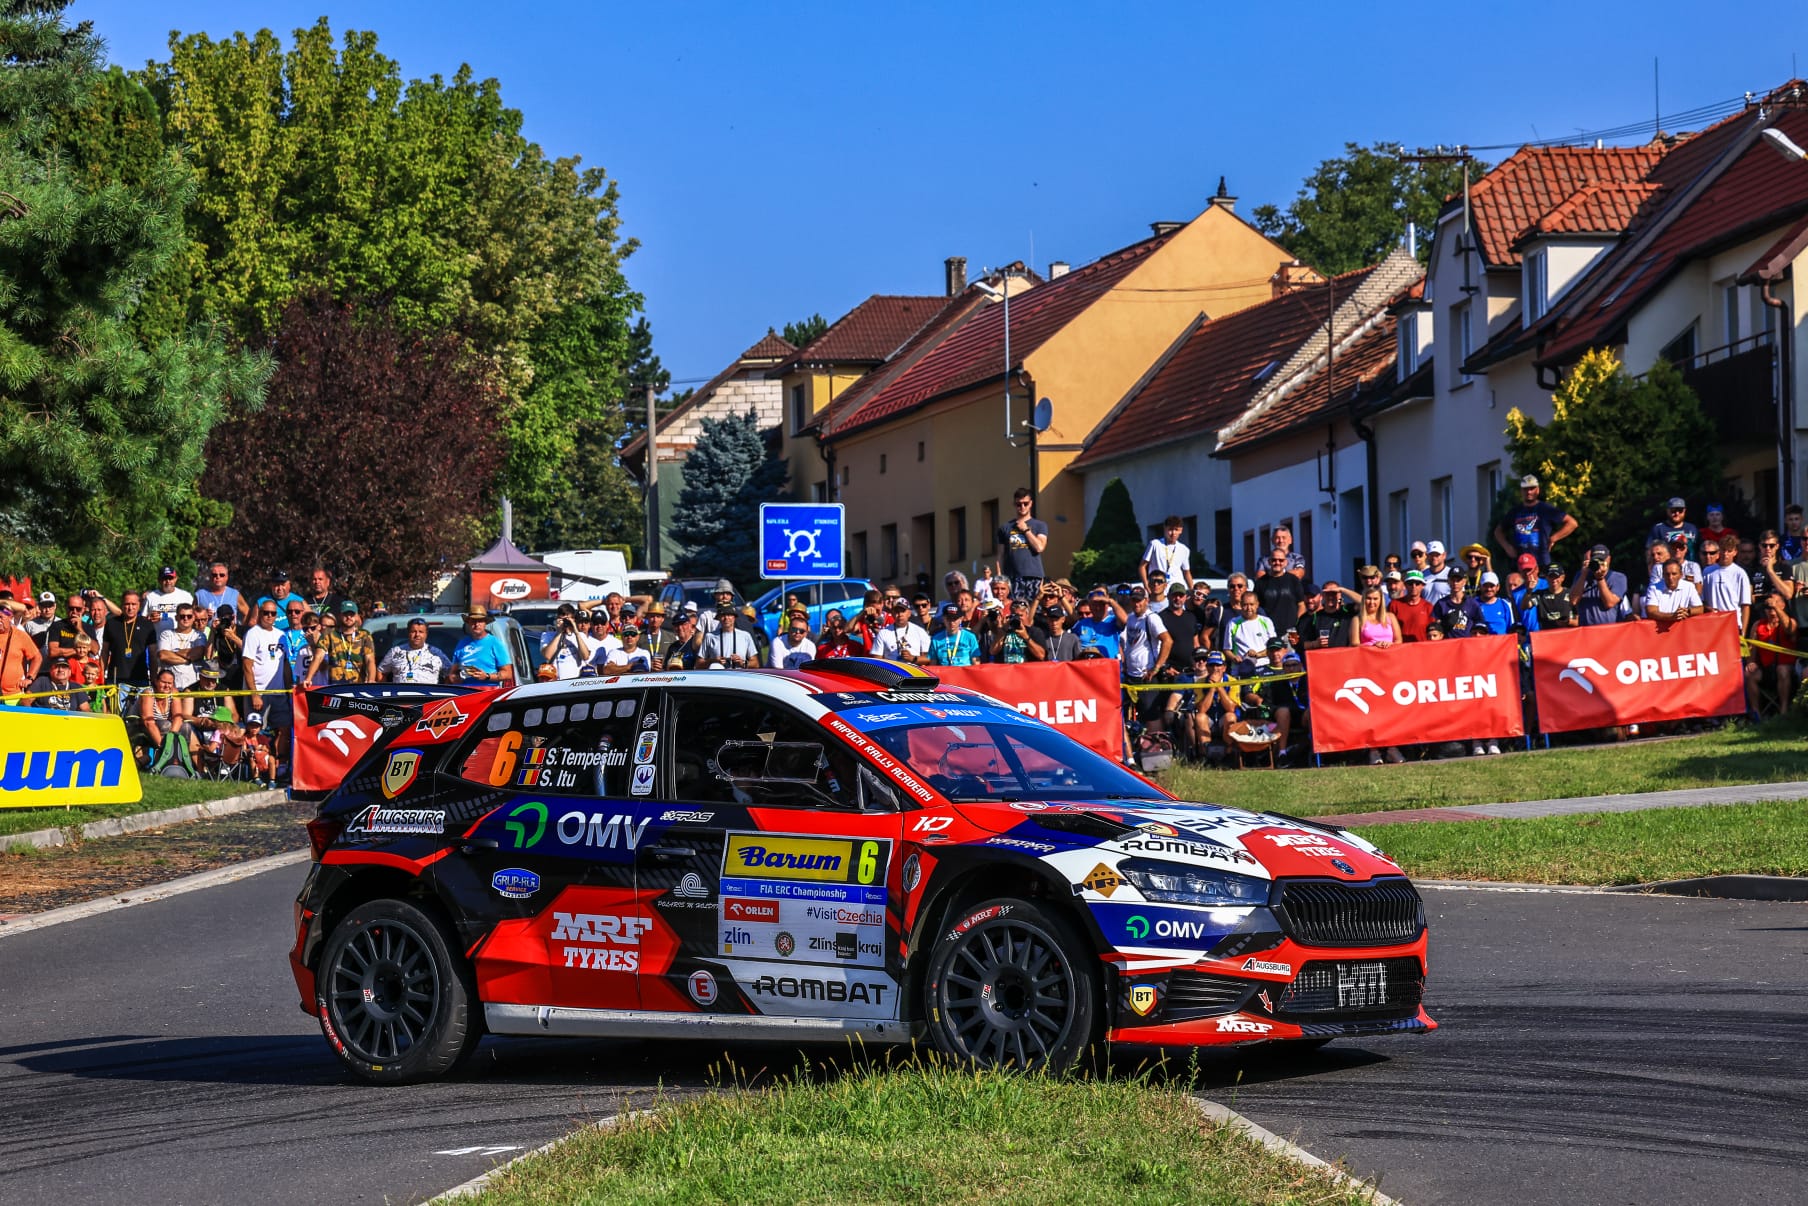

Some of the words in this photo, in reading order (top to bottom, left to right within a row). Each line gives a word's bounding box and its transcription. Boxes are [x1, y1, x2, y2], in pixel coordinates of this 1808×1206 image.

[1615, 651, 1720, 685] ORLEN
[1392, 674, 1498, 706] ORLEN
[415, 713, 469, 731] NRF
[1017, 699, 1097, 724] RLEN
[390, 760, 414, 777] BT
[488, 731, 523, 787] 6
[545, 748, 558, 766] S.
[560, 747, 628, 770] Tempestini
[830, 720, 867, 746] NAPOCA
[863, 745, 894, 768] RALLY
[891, 767, 934, 802] ACADEMY
[0, 748, 123, 791] um
[540, 768, 553, 787] S.
[556, 770, 577, 787] Itu
[375, 809, 445, 825] AUGSBURG
[557, 811, 653, 850] OMV
[738, 845, 842, 871] Barum
[857, 840, 879, 885] 6
[760, 884, 773, 894] FIA
[775, 885, 791, 895] ERC
[792, 886, 847, 900] Championship
[745, 906, 774, 916] ORLEN
[806, 907, 883, 924] #VisitCzechia
[970, 909, 993, 925] MRF
[551, 912, 653, 945] MRF
[1155, 920, 1205, 939] OMV
[808, 936, 838, 951] Zlíns
[858, 940, 882, 957] kraj
[563, 946, 639, 972] TYRES
[1256, 962, 1291, 973] AUGSBURG
[695, 978, 710, 998] E
[752, 975, 888, 1005] ROMBAT
[1135, 991, 1151, 1002] BT
[1216, 1019, 1273, 1033] MRF
